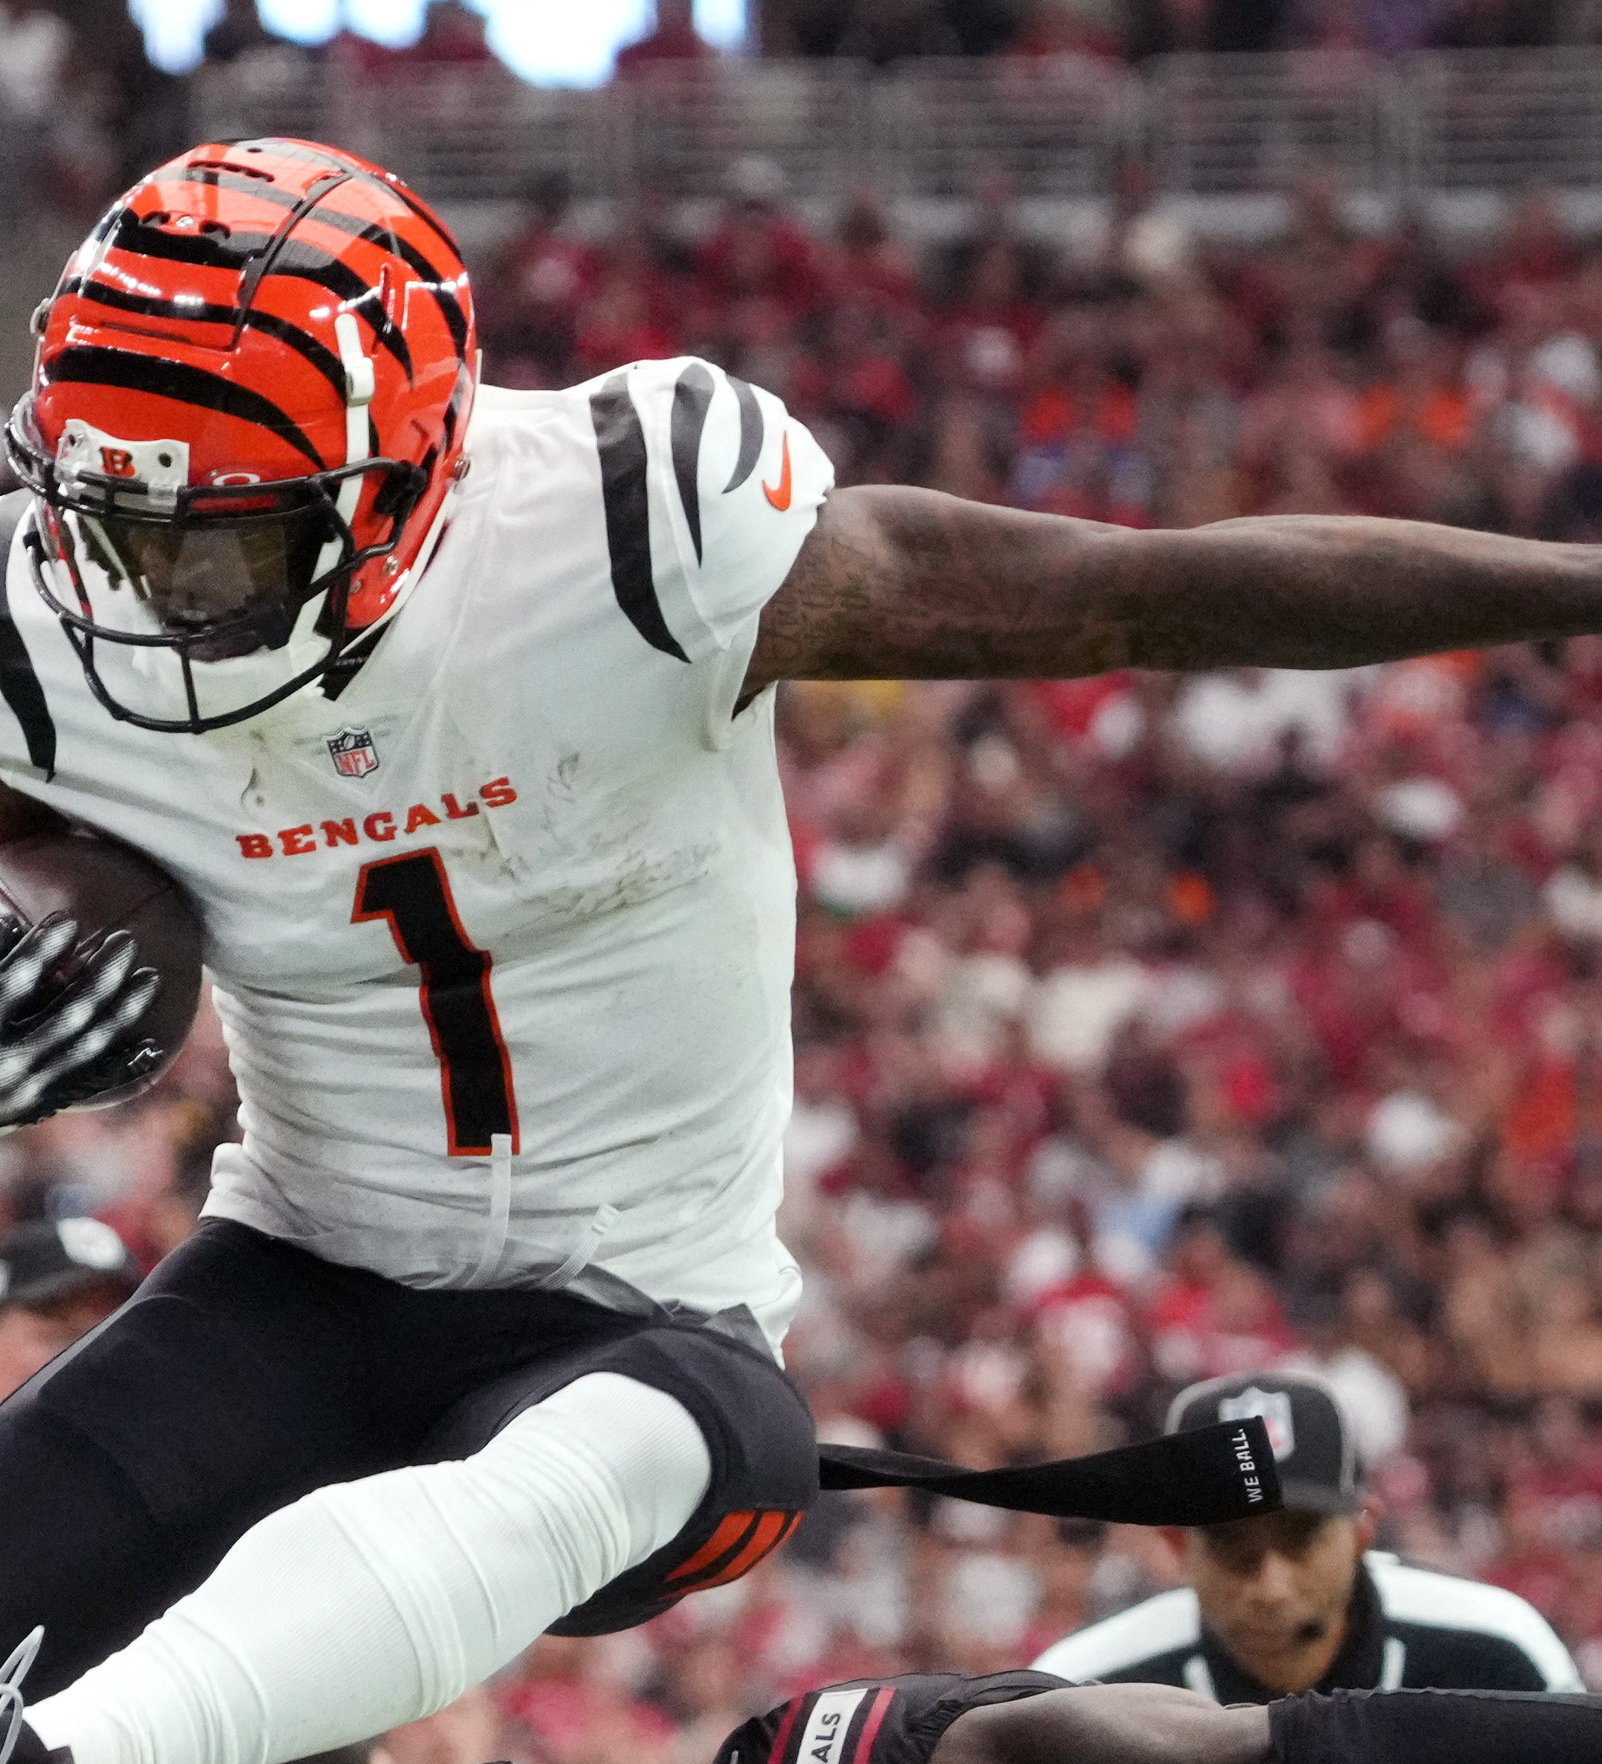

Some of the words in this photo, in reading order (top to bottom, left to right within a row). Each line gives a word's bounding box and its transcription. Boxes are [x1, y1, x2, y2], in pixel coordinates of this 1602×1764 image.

[336, 749, 375, 774] NFL
[235, 776, 518, 859] BENGALS
[351, 846, 520, 1157] 1
[1231, 1428, 1256, 1472] BALL.
[1244, 1475, 1264, 1503] WE
